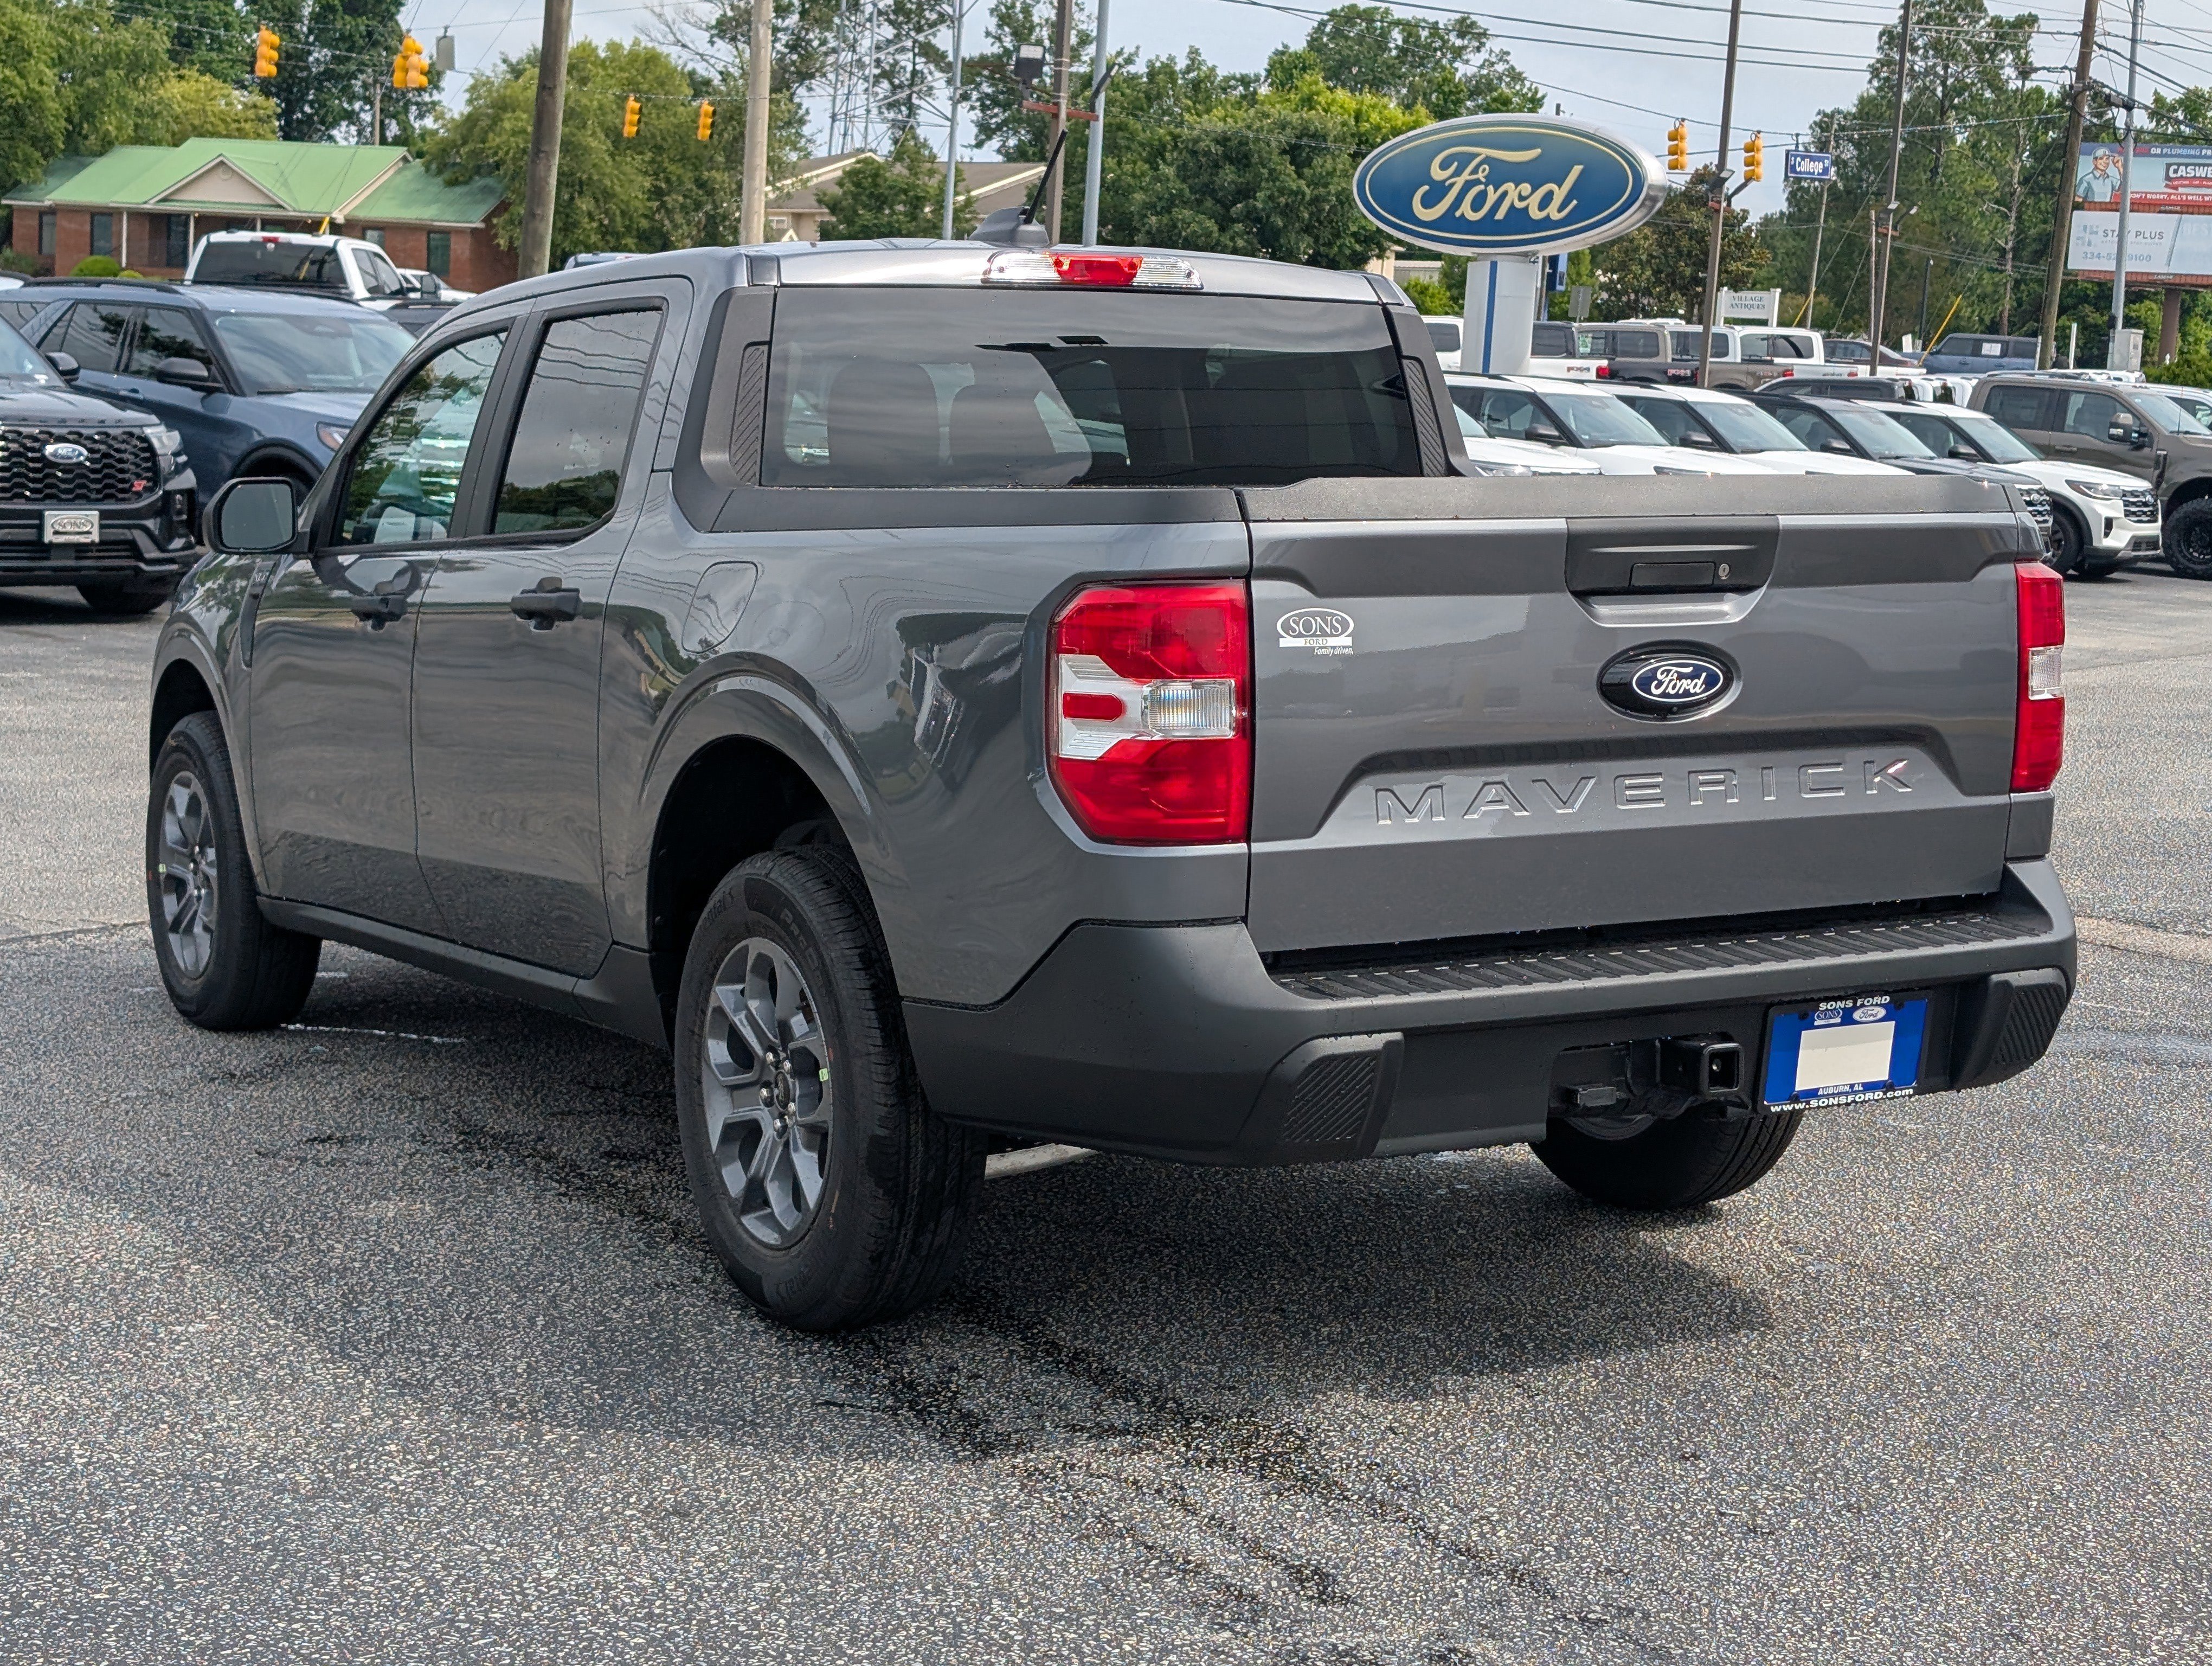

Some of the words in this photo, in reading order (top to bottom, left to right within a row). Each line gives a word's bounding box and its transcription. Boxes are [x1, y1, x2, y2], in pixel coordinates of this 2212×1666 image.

[2162, 148, 2200, 156] PLUMBING
[1790, 157, 1795, 165] S
[1796, 156, 1823, 176] College
[1412, 145, 1584, 221] Ford
[2134, 230, 2164, 240] PLUS
[1729, 302, 1766, 310] ANTIQUES
[57, 519, 89, 530] SONS
[1289, 616, 1342, 636] SONS
[1314, 646, 1334, 656] Family
[1334, 646, 1354, 655] driven.
[1650, 666, 1707, 695] Ford
[1374, 758, 1913, 825] MAVERICK
[1819, 999, 1853, 1011] SONS
[1856, 996, 1891, 1007] FORD
[1818, 1009, 1841, 1020] SONS
[1859, 1009, 1879, 1020] Ford
[1817, 1084, 1852, 1095] AUBURN,
[1853, 1083, 1863, 1092] AL
[1770, 1088, 1914, 1113] www.SONSFORD.com
